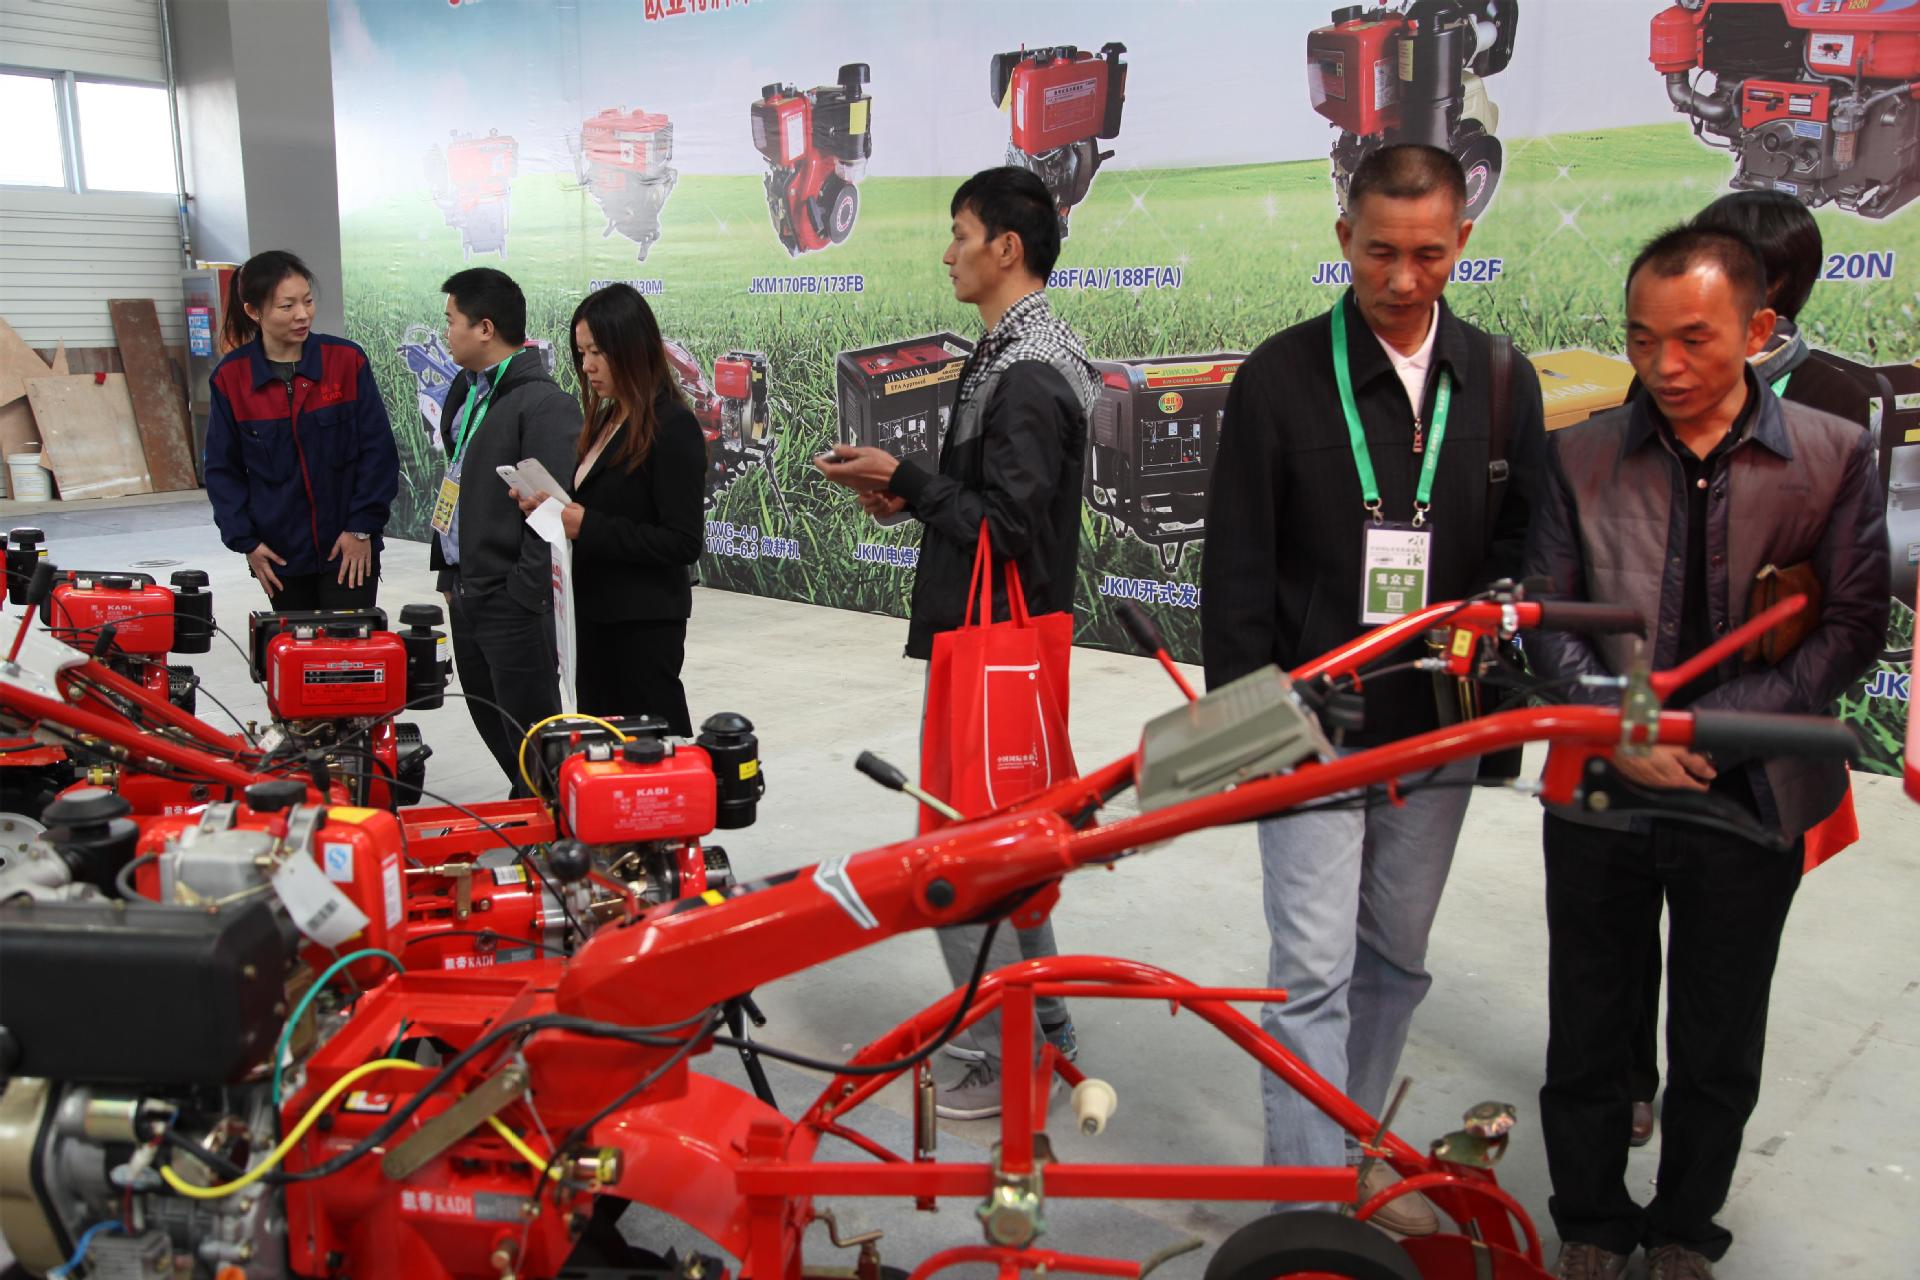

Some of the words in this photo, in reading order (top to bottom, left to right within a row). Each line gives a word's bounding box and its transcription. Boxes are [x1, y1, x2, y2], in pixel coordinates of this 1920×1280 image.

[1817, 252, 1893, 279] 20N
[749, 275, 864, 293] JKM170FB/173FB
[1049, 267, 1182, 289] 86F(A)/188F(A)
[886, 367, 930, 383] JINKAMA
[761, 536, 800, 560] 微耕机
[1099, 576, 1200, 609] JKM开式发
[1865, 671, 1910, 699] JK
[636, 787, 670, 796] KADI
